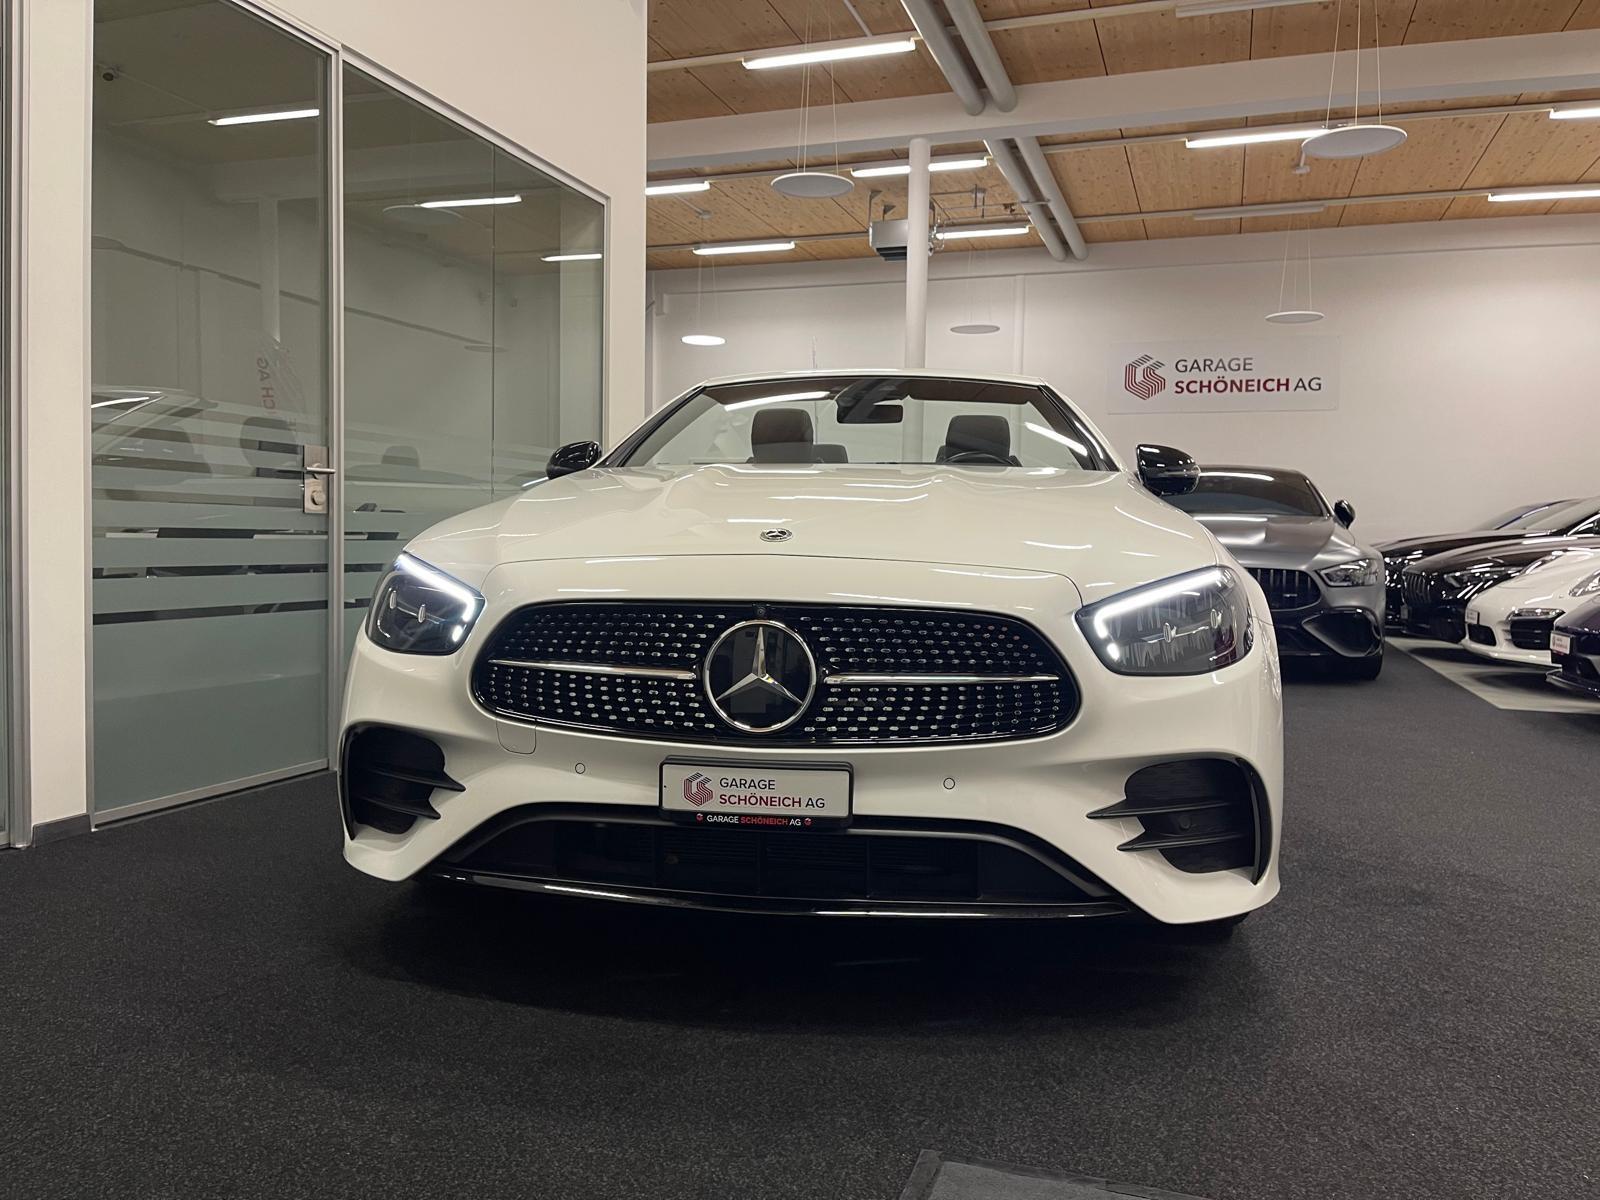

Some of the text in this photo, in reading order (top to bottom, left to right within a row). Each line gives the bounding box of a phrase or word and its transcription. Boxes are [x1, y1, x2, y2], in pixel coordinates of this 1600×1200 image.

[1175, 357, 1253, 373] GARAGE
[1174, 376, 1322, 394] SCHÖNEICH AG
[719, 777, 776, 790] GARAGE
[719, 792, 825, 809] SCHÖNEICH AG
[706, 814, 802, 827] GARAGE SCHÖNEICH AG
